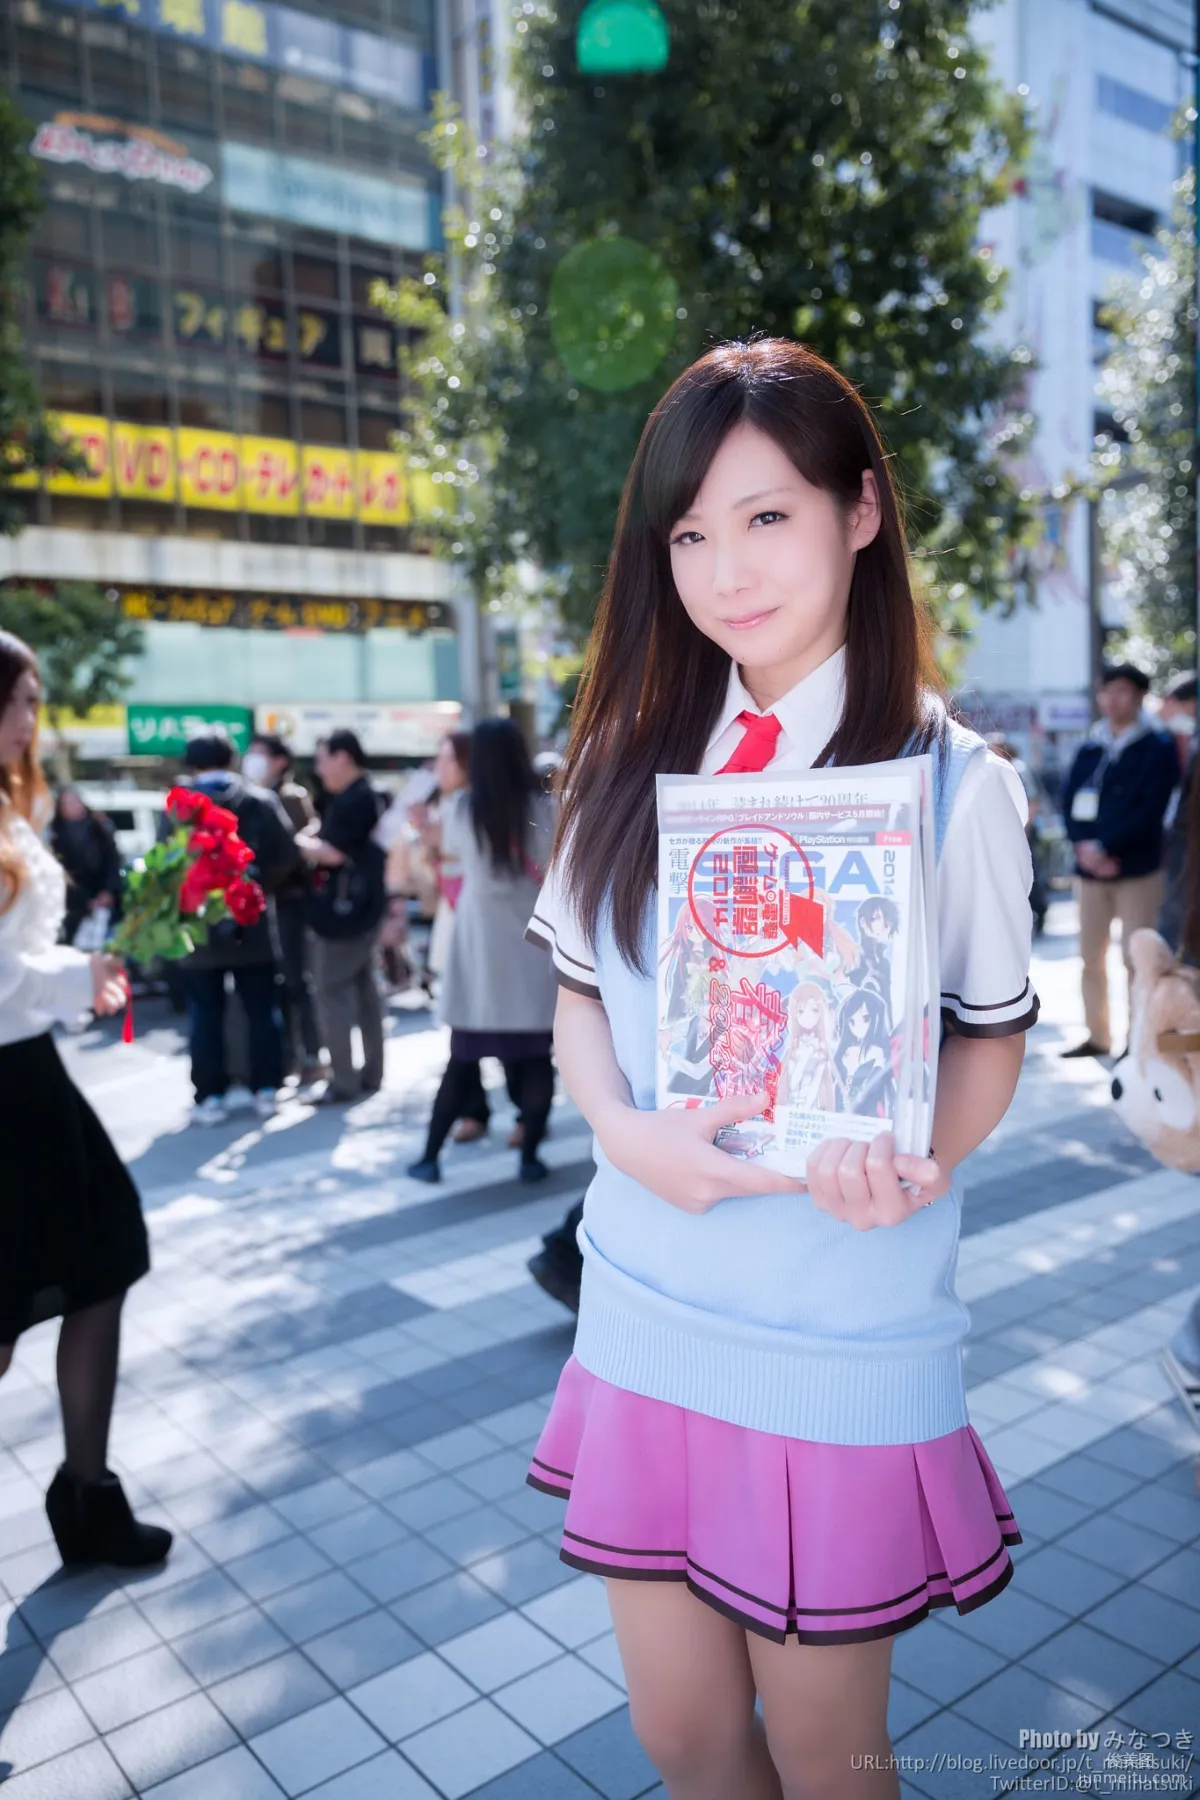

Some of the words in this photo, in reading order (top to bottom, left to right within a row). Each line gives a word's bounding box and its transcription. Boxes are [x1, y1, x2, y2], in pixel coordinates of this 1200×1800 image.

[799, 834, 846, 845] PlayStation
[713, 853, 729, 927] 2014
[883, 850, 896, 896] 2014
